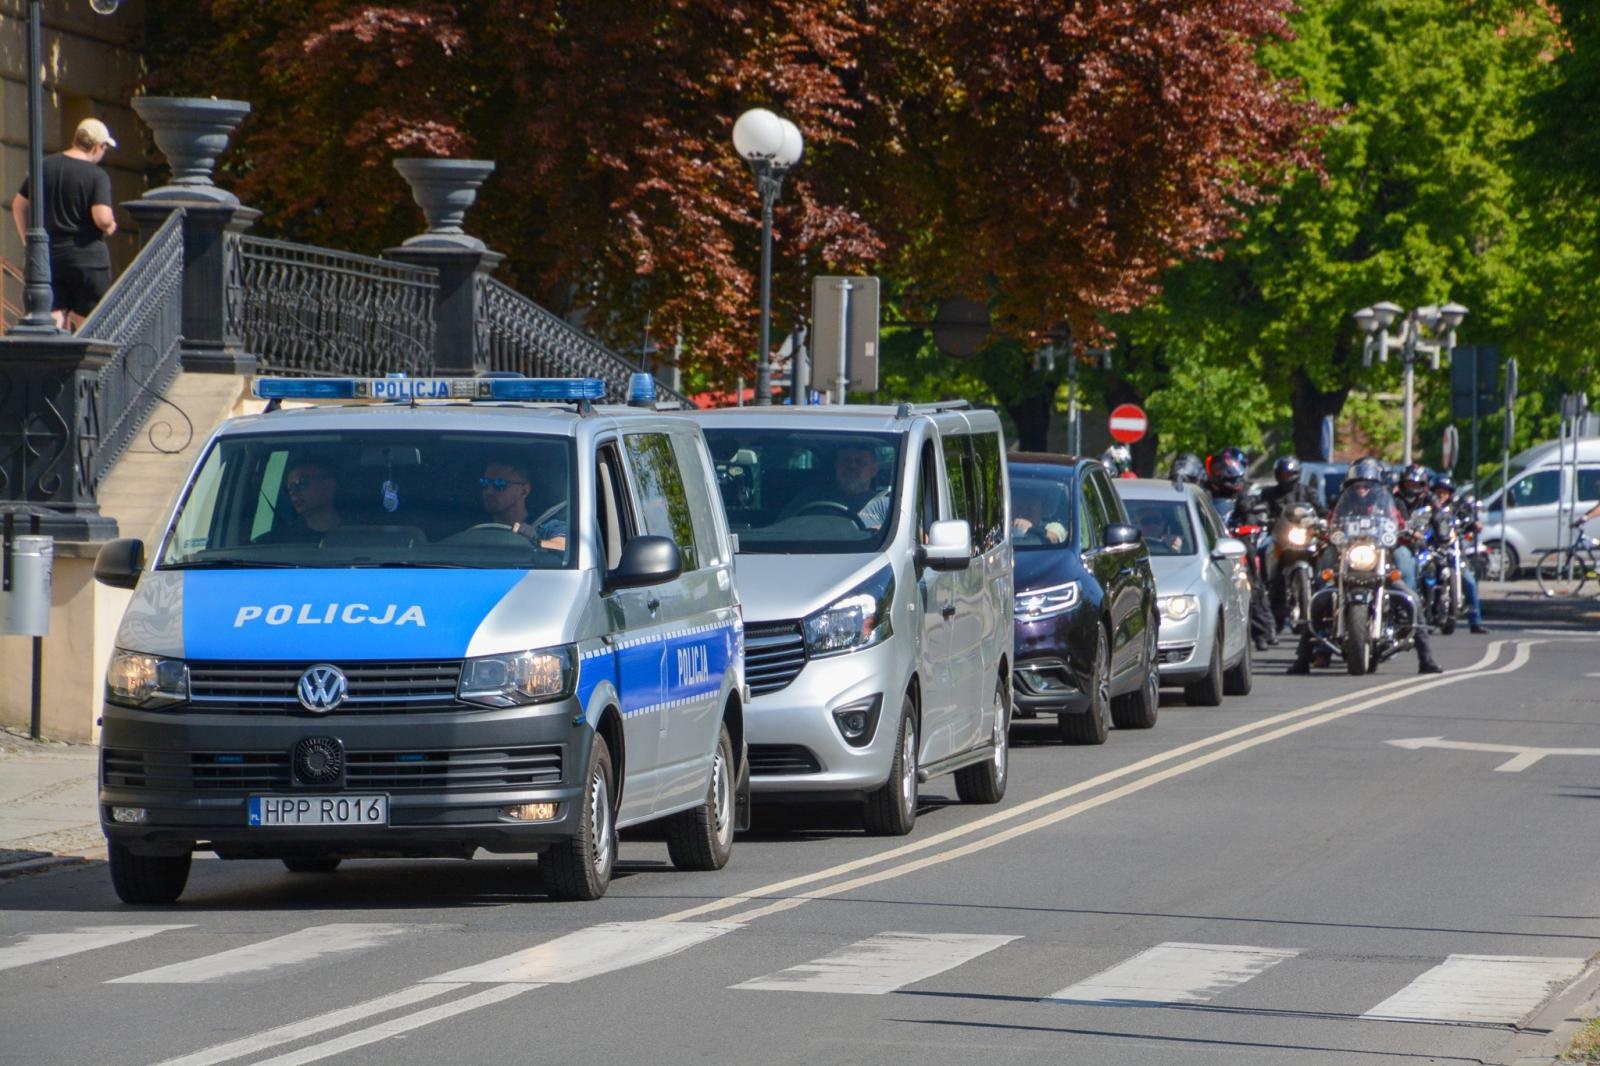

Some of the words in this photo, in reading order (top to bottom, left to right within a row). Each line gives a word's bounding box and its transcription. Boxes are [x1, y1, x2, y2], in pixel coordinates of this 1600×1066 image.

[374, 381, 449, 398] POLICJA
[233, 603, 426, 628] POLICJA
[677, 644, 709, 688] POLICJA
[266, 799, 310, 823] HPP
[321, 798, 380, 822] R016
